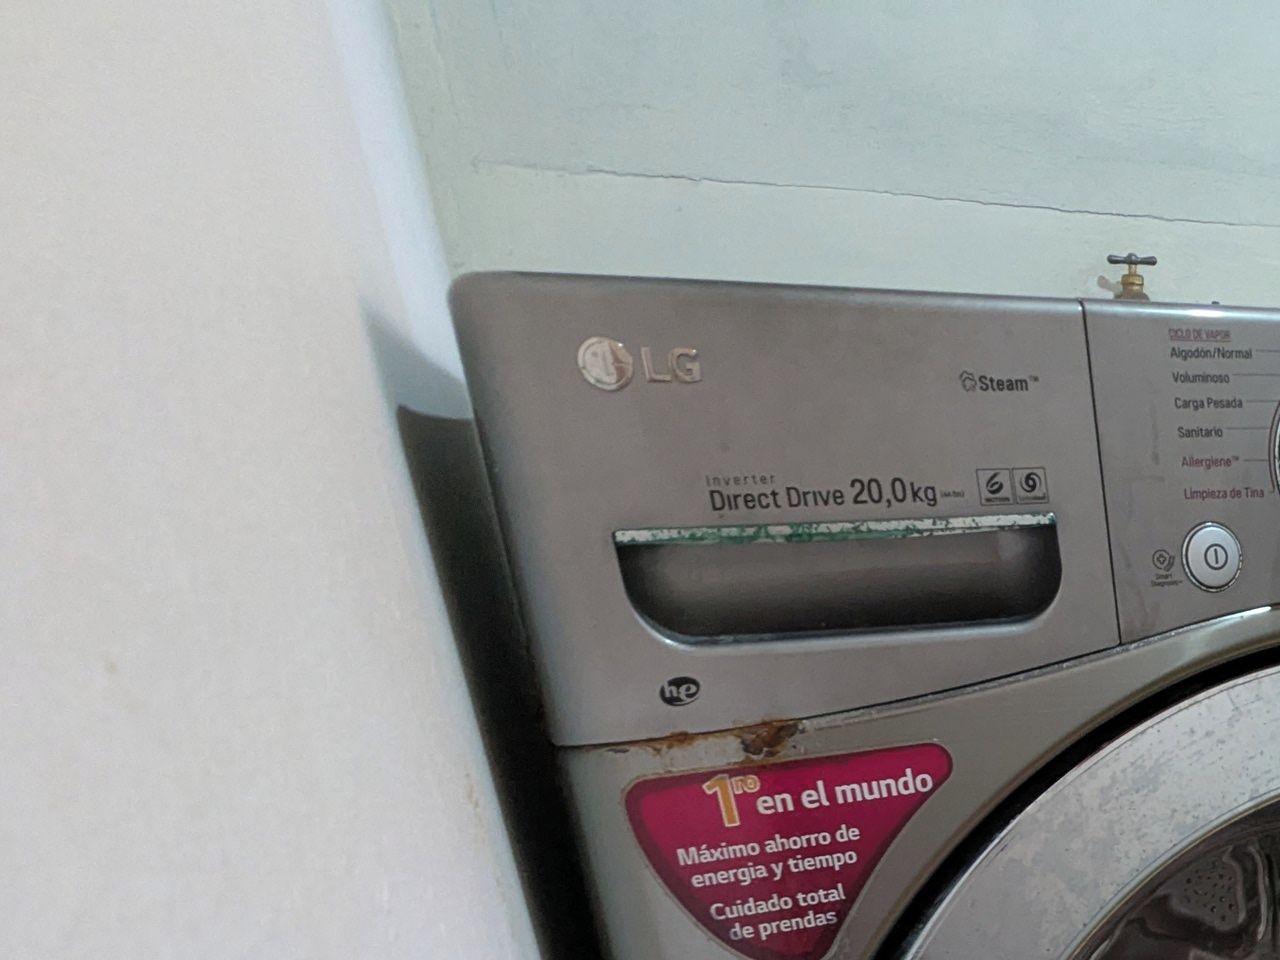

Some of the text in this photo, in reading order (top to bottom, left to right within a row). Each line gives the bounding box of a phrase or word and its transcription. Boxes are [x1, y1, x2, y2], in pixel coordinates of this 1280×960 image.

[641, 346, 702, 383] LG
[1172, 371, 1230, 383] Voluminoso
[1174, 397, 1244, 411] Carga Pesada
[1177, 426, 1223, 438] Sanitario
[706, 473, 776, 488] Inverter
[1184, 487, 1265, 501] Limpieza de Tina
[709, 488, 782, 512] Direct
[785, 485, 845, 508] Drive
[756, 790, 794, 816] en
[801, 780, 830, 810] el
[836, 768, 934, 805] mundo
[676, 824, 861, 867] Máximo ahorro de
[772, 861, 784, 881] y
[788, 849, 858, 875] tiempo
[709, 882, 846, 921] Cuidado total
[729, 910, 839, 941] de prendas
